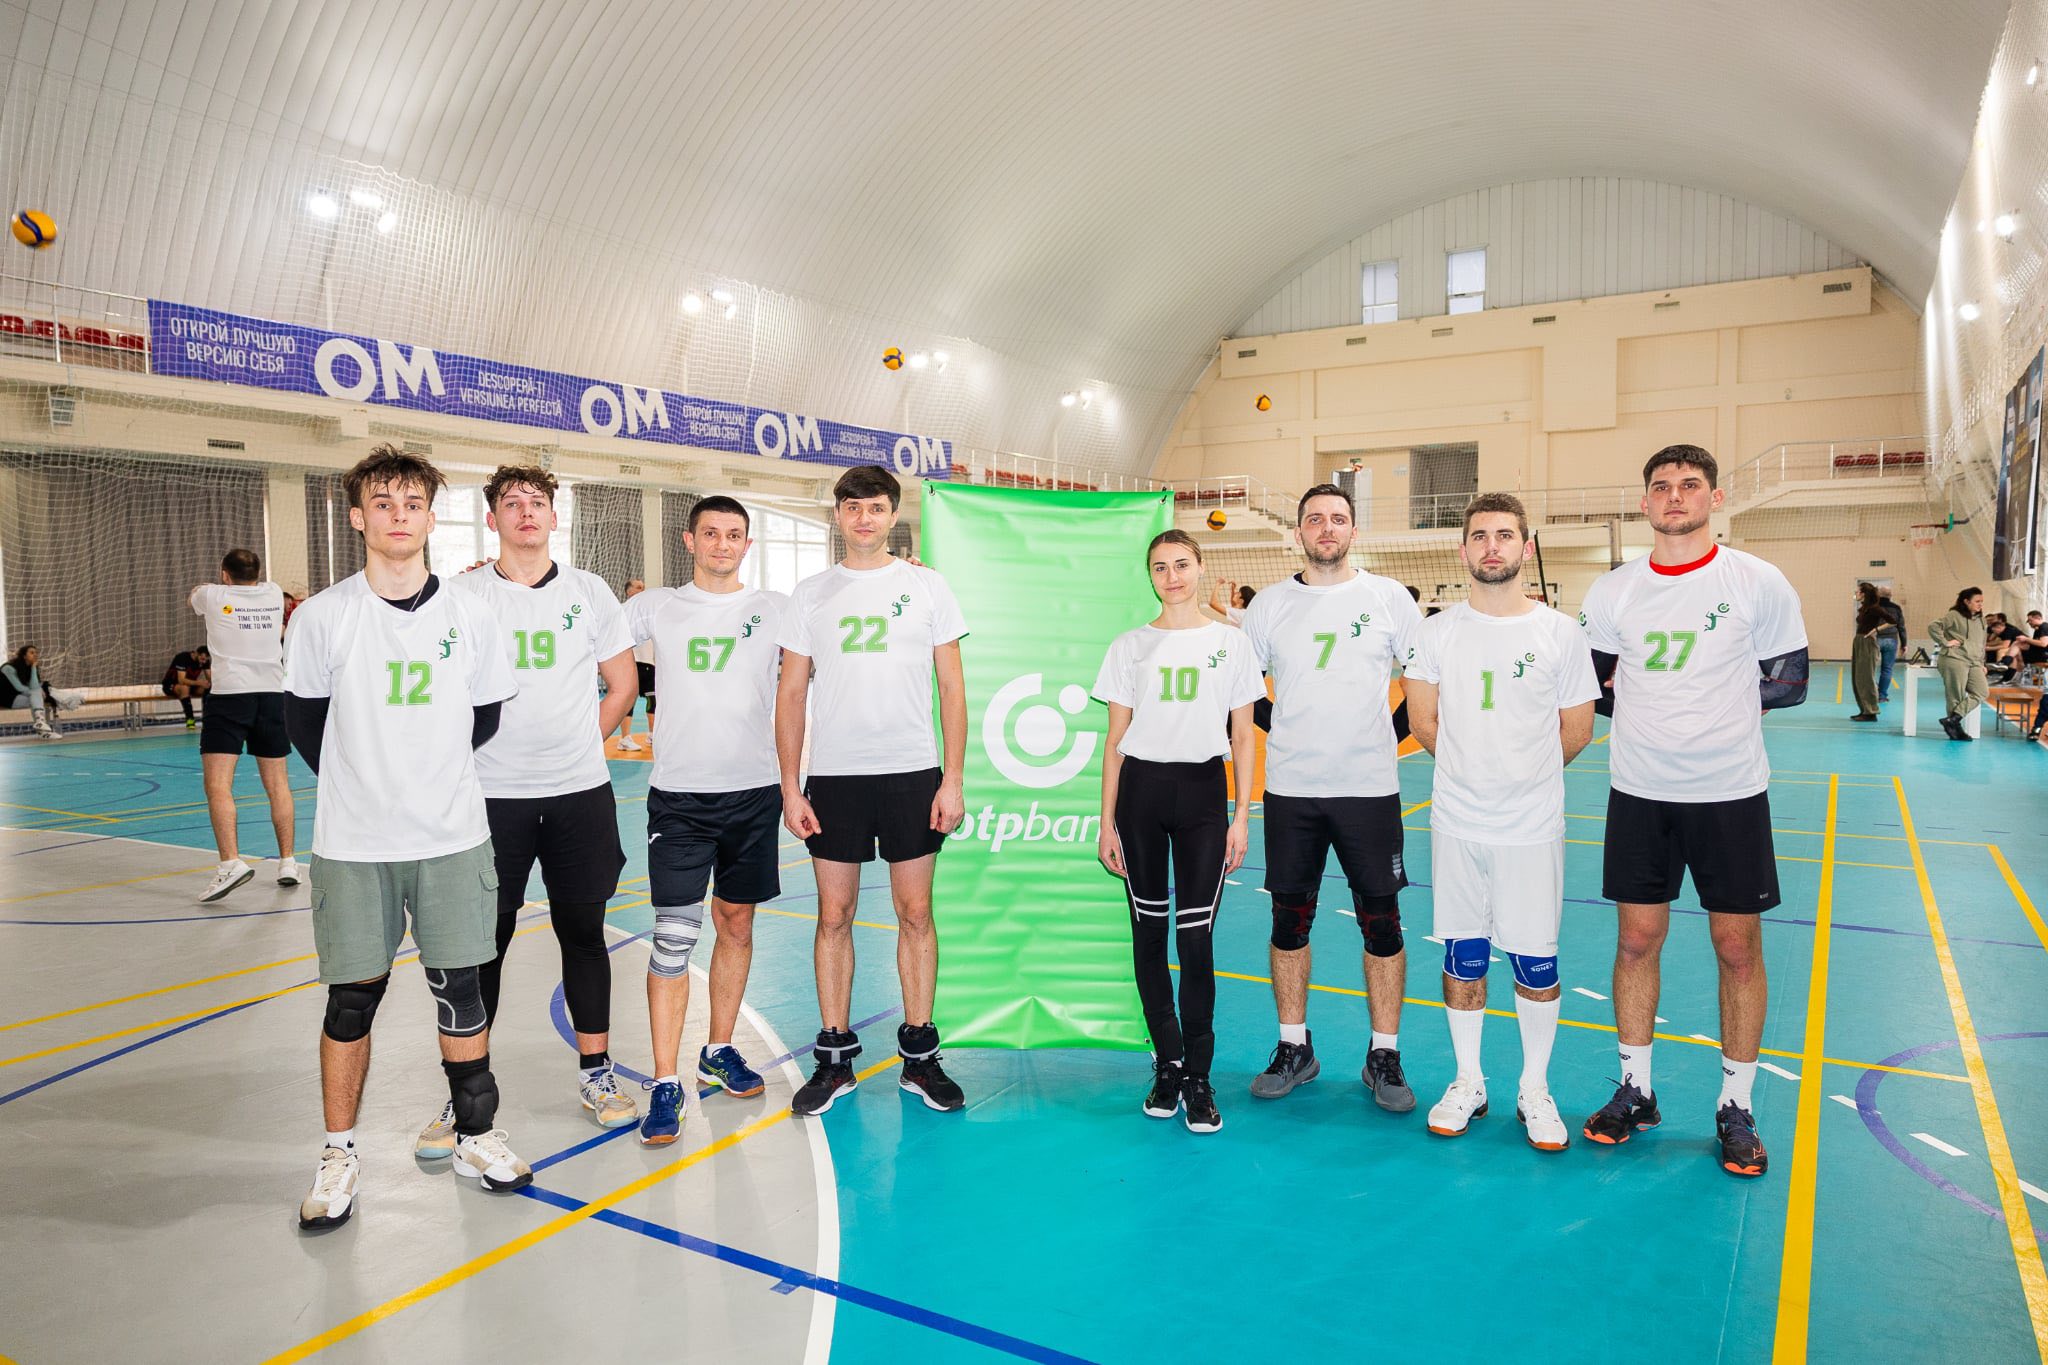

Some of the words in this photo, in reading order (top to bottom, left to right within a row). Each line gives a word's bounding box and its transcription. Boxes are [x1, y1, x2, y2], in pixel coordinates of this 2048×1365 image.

[170, 317, 228, 344] ОТКРОЙ
[232, 327, 296, 354] ЛУЧШУЮ
[186, 341, 246, 368] ВЕРСИЮ
[250, 352, 285, 374] СЕБЯ
[314, 337, 446, 402] OM
[460, 387, 516, 411] VERSIUNEA
[517, 397, 562, 417] PERFECTĂ
[580, 384, 671, 437] OM
[753, 412, 823, 458] OM
[893, 435, 947, 477] OM
[513, 629, 556, 669] 19
[687, 636, 736, 672] 67
[839, 615, 888, 653] 22
[1313, 632, 1337, 670] 7
[1644, 631, 1697, 671] 27
[386, 660, 432, 705] 12
[1159, 666, 1200, 702] 10
[1480, 670, 1495, 711] 1
[950, 800, 1102, 852] otpban
